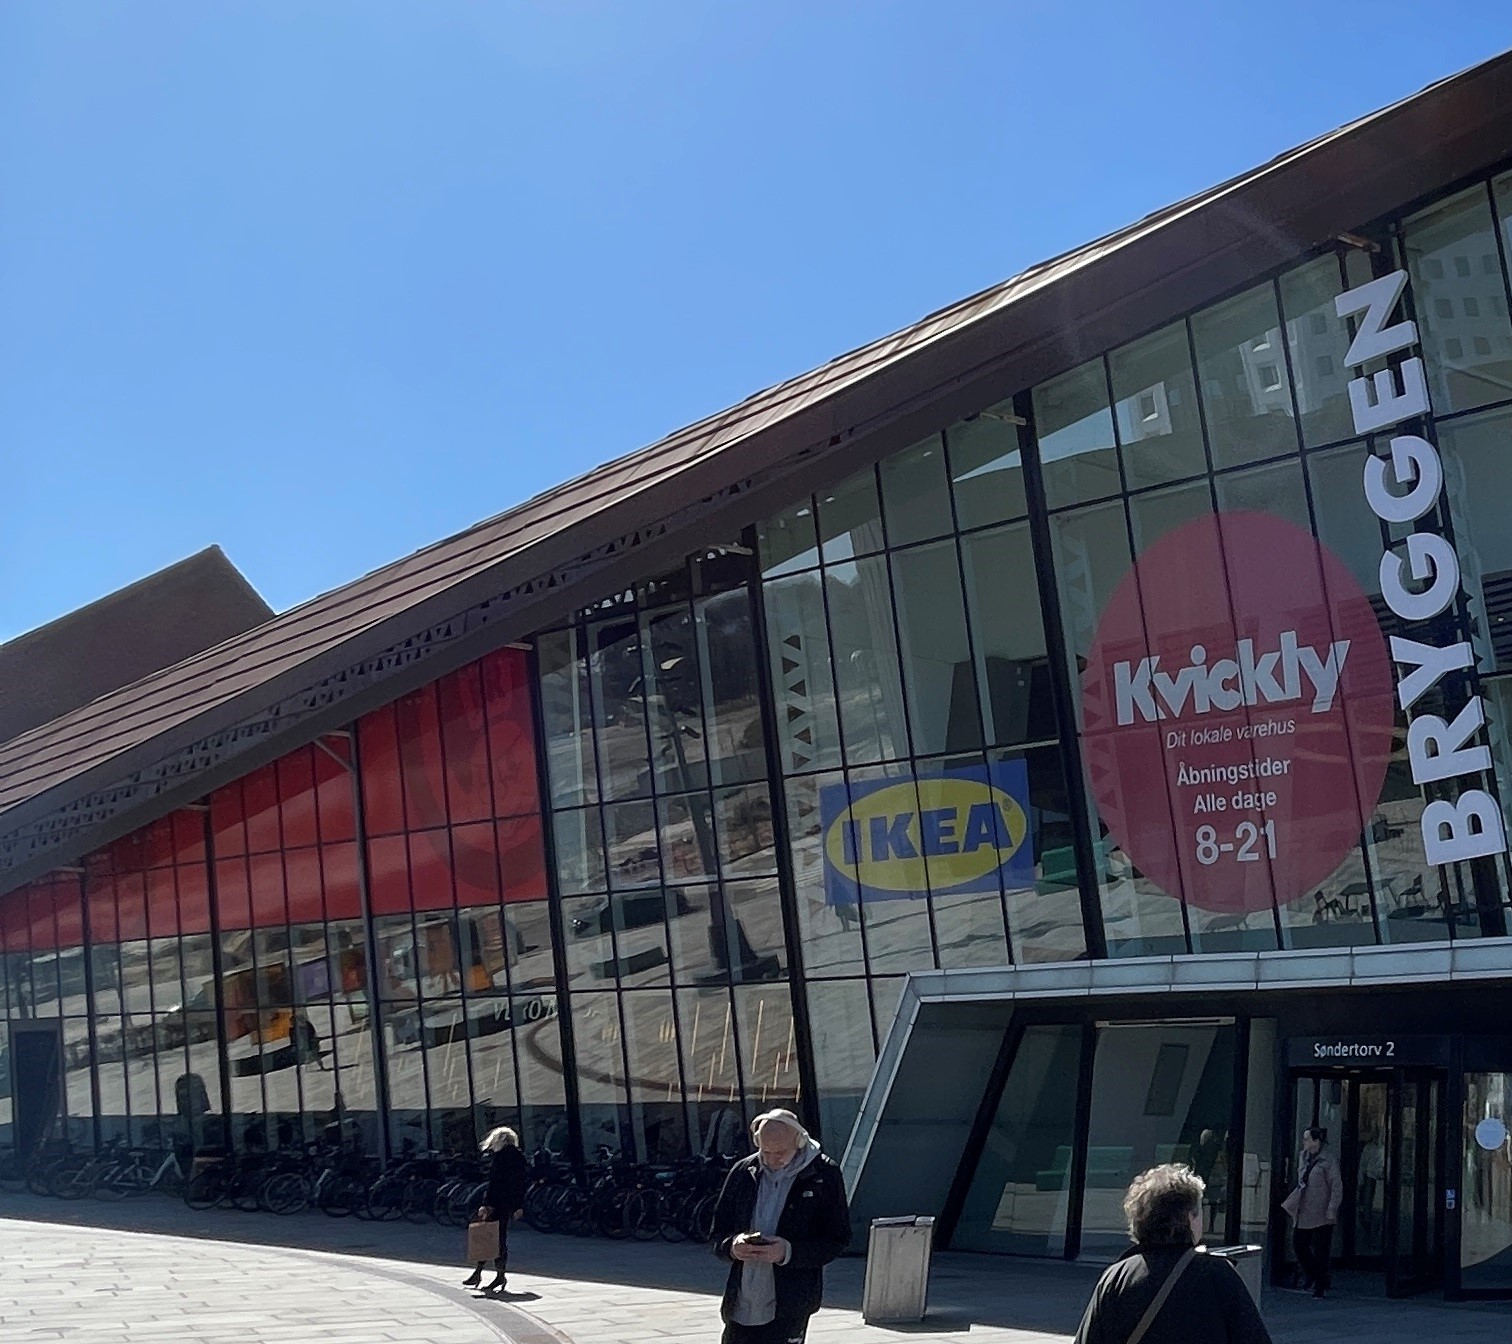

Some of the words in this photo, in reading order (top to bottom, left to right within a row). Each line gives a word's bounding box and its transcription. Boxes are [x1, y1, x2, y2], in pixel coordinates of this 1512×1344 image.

[1334, 268, 1506, 866] BRYGGEN
[1114, 630, 1351, 726] Kvickly
[1166, 731, 1187, 749] Dit
[1190, 725, 1232, 745] lokale
[1236, 718, 1296, 740] varehus
[1176, 757, 1291, 786] Åbningstider
[1194, 794, 1226, 814] Alle
[1232, 790, 1277, 813] dage
[841, 801, 1013, 865] IKEA
[1195, 820, 1277, 865] 8-21
[1313, 1041, 1382, 1058] Søndertorv
[1386, 1041, 1395, 1057] 2
